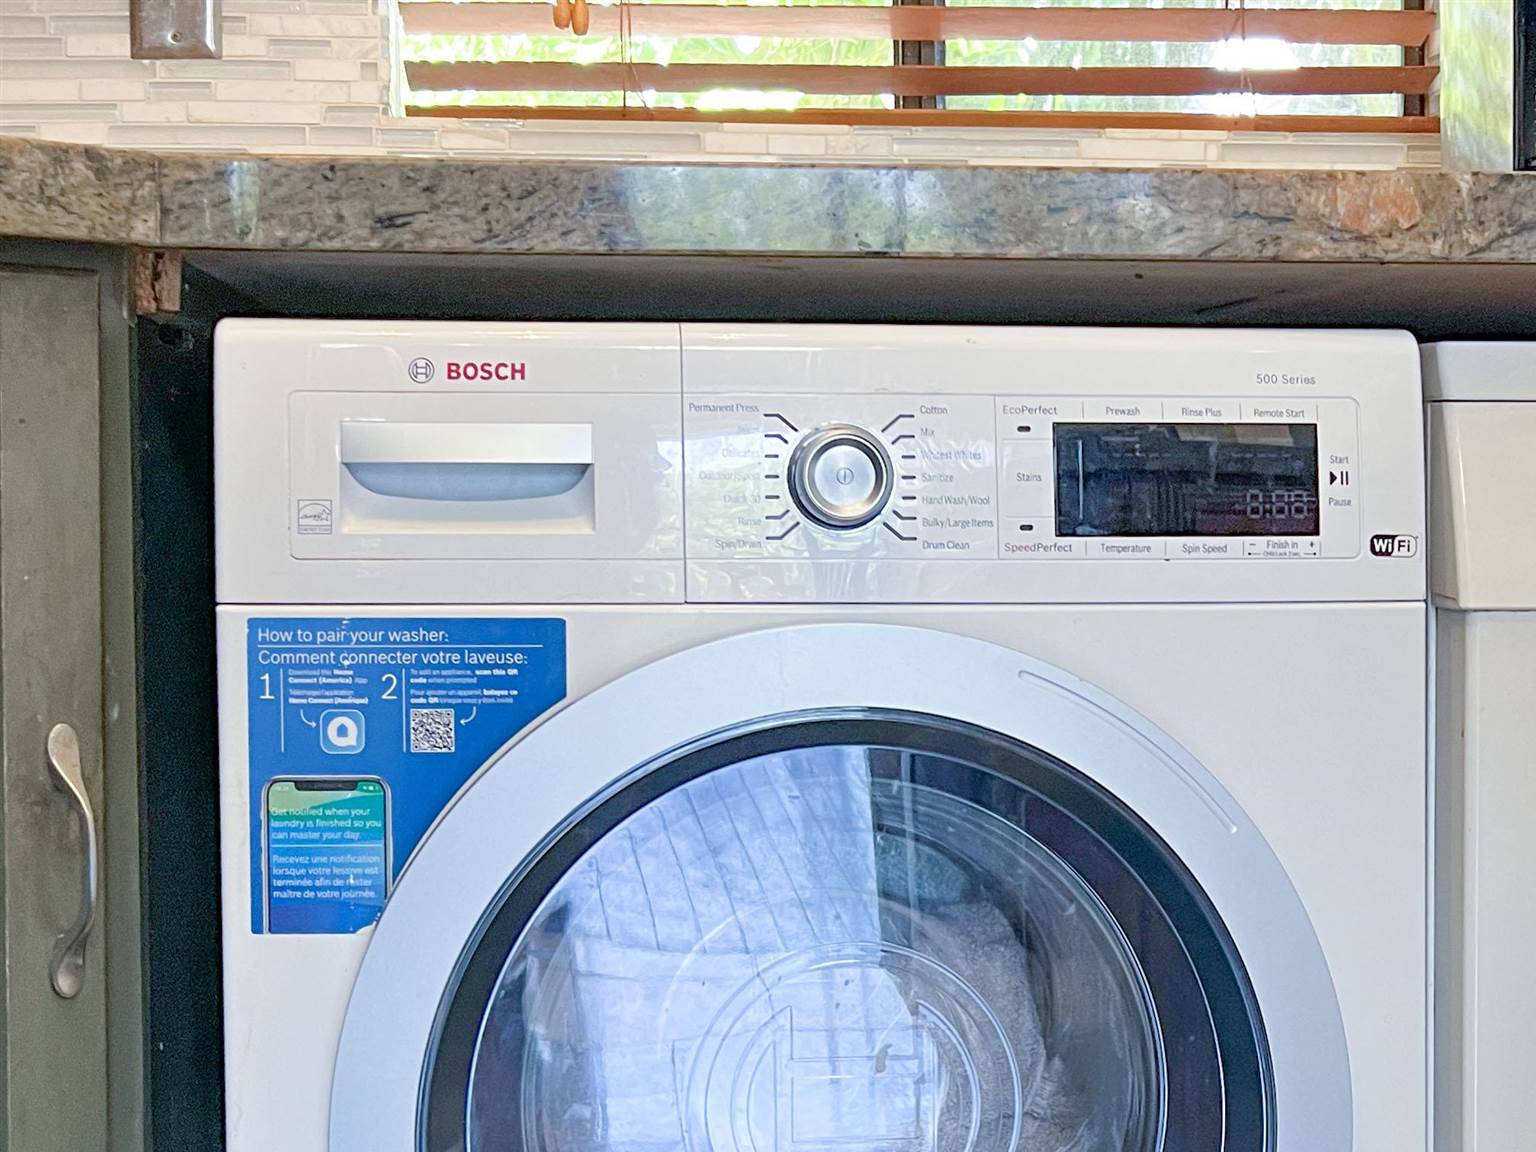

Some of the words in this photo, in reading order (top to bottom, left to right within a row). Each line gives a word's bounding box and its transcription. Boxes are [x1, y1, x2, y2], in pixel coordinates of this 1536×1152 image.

[446, 362, 527, 381] BOSCH
[1256, 373, 1278, 385] 500
[1281, 373, 1317, 385] Series
[688, 402, 734, 412] Permanent
[736, 402, 759, 412] Press
[919, 404, 948, 415] Cotton
[1002, 405, 1058, 416] EcoPerfect
[1105, 405, 1140, 416] Prewash
[1181, 406, 1204, 417] Rinse
[1204, 406, 1222, 417] Plus
[1253, 407, 1284, 418] Remote
[1285, 407, 1305, 418] Start
[1329, 454, 1350, 464] Start
[1016, 472, 1042, 482] Stains
[921, 495, 943, 505] Hand
[1328, 497, 1352, 507] Pause
[922, 541, 945, 550] Drum
[946, 541, 970, 550] Clean
[1003, 543, 1073, 554] SpeedPerfect
[1101, 543, 1152, 554] Temperature
[1182, 543, 1201, 554] Spin
[1202, 543, 1228, 554] Speed
[1266, 540, 1290, 549] Finish
[257, 628, 293, 643] How
[297, 628, 313, 643] to
[316, 627, 347, 646] pair
[350, 631, 386, 646] your
[388, 627, 449, 643] washer:
[258, 650, 336, 665] Comment
[339, 651, 418, 665] connecter
[421, 650, 461, 665] votre
[464, 650, 529, 665] laveuse:
[259, 672, 275, 700] 1
[381, 672, 398, 700] 2
[324, 807, 350, 816] when
[351, 808, 371, 818] your
[353, 820, 364, 828] so
[365, 820, 383, 829] you
[271, 831, 289, 840] can
[290, 831, 321, 840] master
[322, 832, 342, 841] your
[311, 855, 328, 864] une
[329, 854, 381, 864] notification
[272, 867, 307, 877] lorsque
[308, 867, 332, 876] votre
[364, 867, 379, 876] est
[314, 877, 332, 887] afin
[332, 878, 345, 887] de
[303, 889, 316, 899] de
[317, 890, 340, 899] votre
